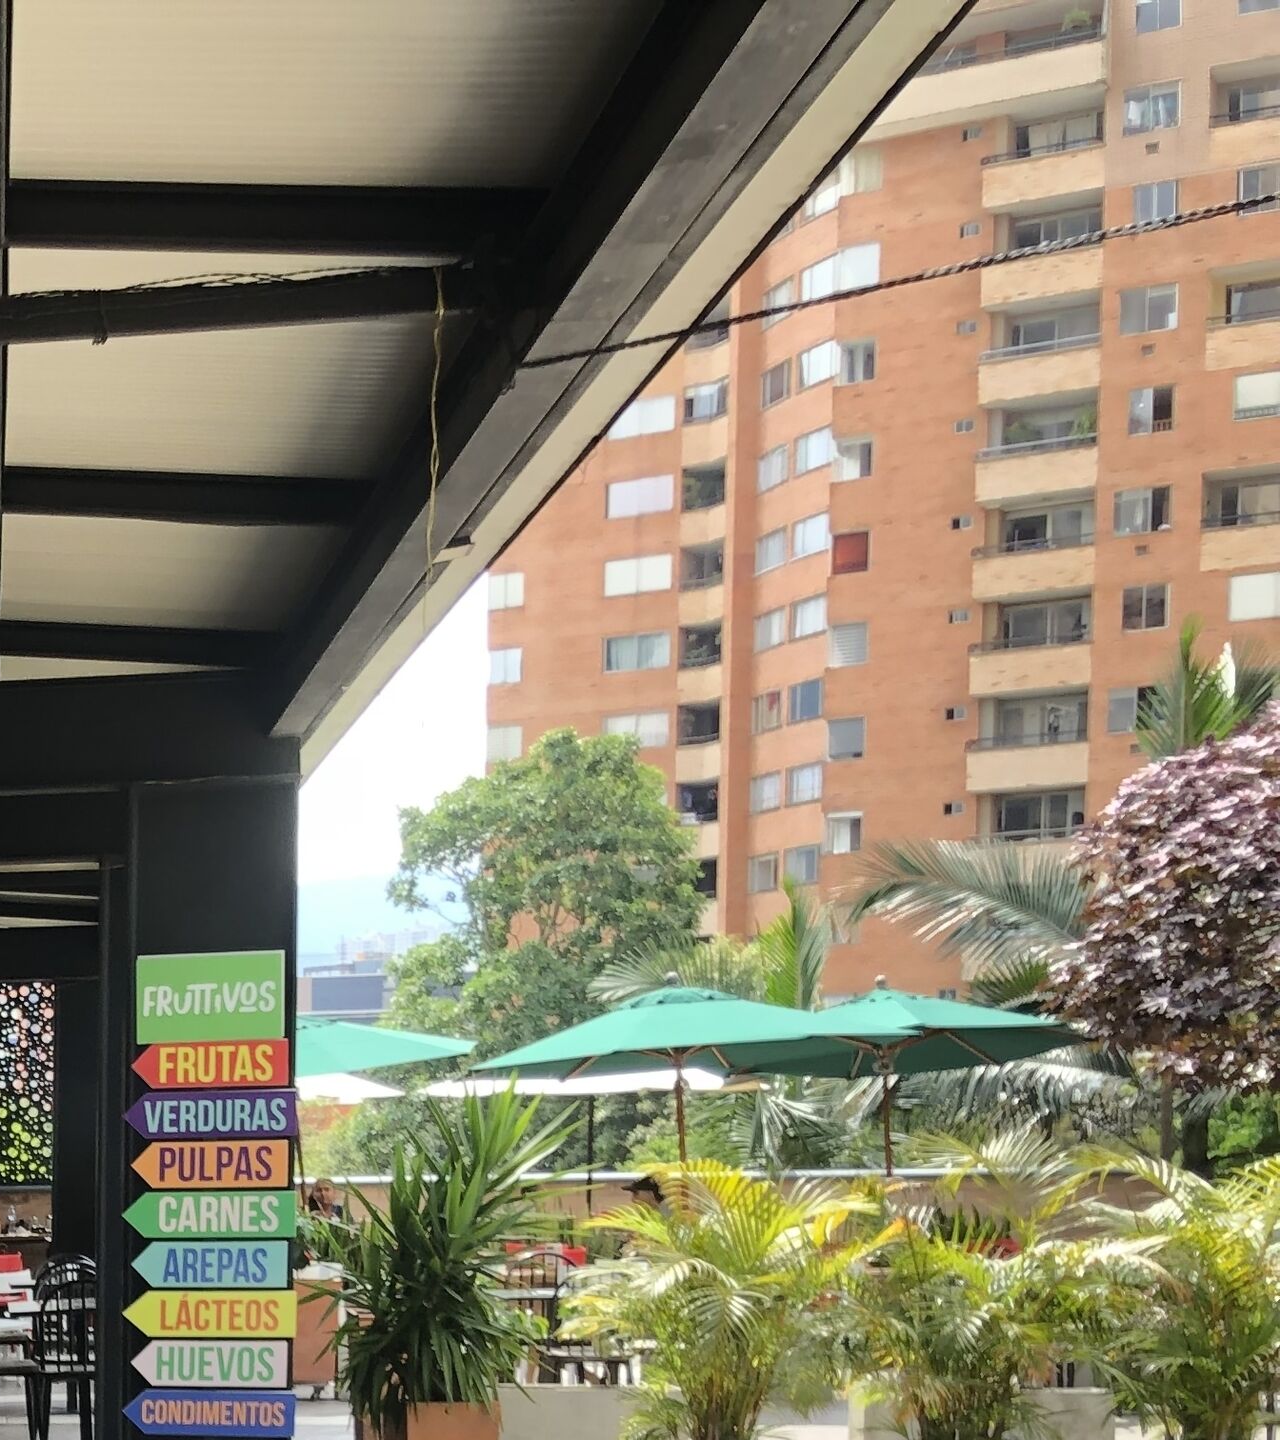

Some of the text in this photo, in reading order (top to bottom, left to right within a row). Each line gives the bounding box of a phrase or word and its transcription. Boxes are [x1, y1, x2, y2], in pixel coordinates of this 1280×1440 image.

[158, 1044, 274, 1084] FRUTAS
[143, 1097, 288, 1134] VERDURAS
[159, 1145, 273, 1183] PULPAS
[158, 1195, 280, 1234] CARNES
[162, 1248, 268, 1284] AREPAS
[159, 1293, 280, 1332] LÁCTEOS
[155, 1346, 275, 1382] HUEVOS
[141, 1398, 286, 1428] CONDIMENTOS
